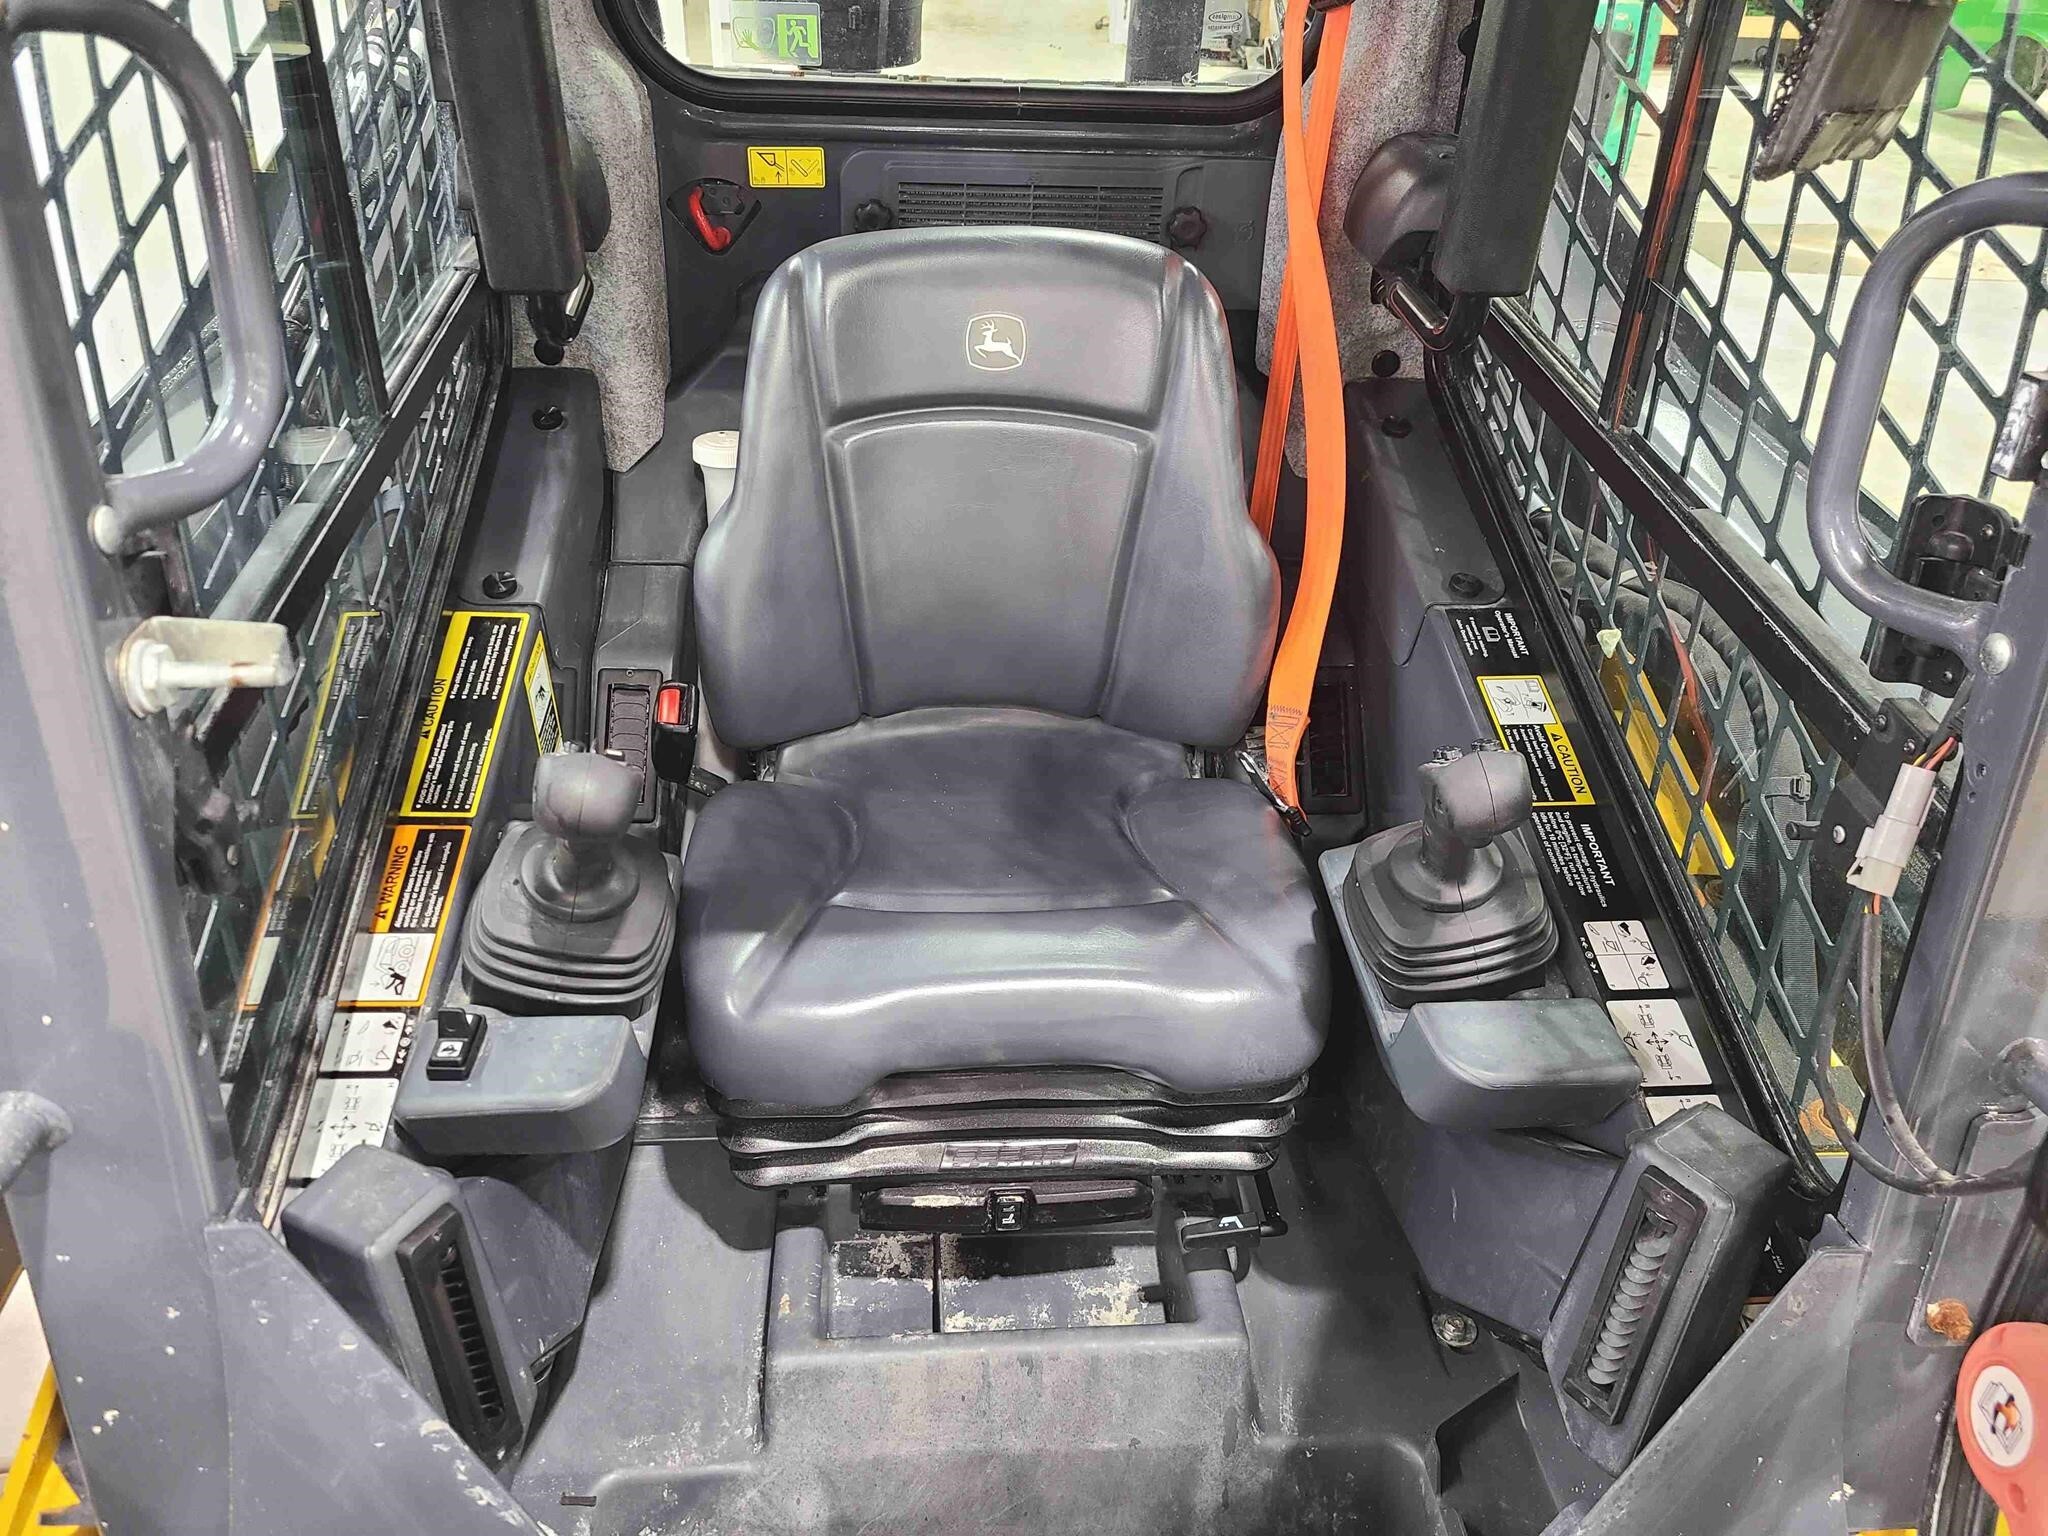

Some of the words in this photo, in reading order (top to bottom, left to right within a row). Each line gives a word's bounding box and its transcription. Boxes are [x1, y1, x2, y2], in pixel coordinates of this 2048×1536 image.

[1466, 625, 1474, 639] contact
[1471, 621, 1480, 635] manual
[1495, 610, 1509, 637] Operator's
[1507, 638, 1519, 658] Manual
[1505, 613, 1528, 654] IMPORTANT
[455, 668, 463, 683] children
[423, 678, 447, 727] CAUTION
[418, 789, 427, 803] AVOID
[423, 771, 432, 788] INJURY
[428, 757, 436, 768] Read
[436, 724, 446, 747] understand
[425, 781, 436, 803] Operator's
[432, 764, 441, 779] Manual
[437, 750, 445, 763] before
[442, 729, 452, 748] operating
[448, 772, 456, 790] location
[455, 745, 464, 762] function
[463, 722, 471, 739] controls.
[1533, 725, 1545, 741] Avoid
[1541, 743, 1556, 769] Overturn
[1557, 745, 1586, 793] CAUTION
[432, 784, 441, 803] machine.
[455, 792, 463, 803] Keep
[459, 778, 467, 791] safety
[463, 761, 472, 777] devices
[468, 742, 478, 760] working.
[1530, 753, 1539, 767] slopes
[1544, 787, 1553, 800] speed
[466, 792, 475, 804] Keep
[1532, 812, 1546, 839] operation
[1546, 848, 1560, 873] controls.
[1547, 812, 1558, 829] below
[1576, 881, 1585, 895] slow
[1552, 842, 1565, 865] minutes
[1562, 867, 1573, 886] before
[1555, 812, 1564, 822] and
[1560, 824, 1572, 845] engine,
[1573, 853, 1592, 893] temperatures
[1565, 820, 1580, 841] prevent
[1576, 843, 1589, 866] damage
[1590, 875, 1607, 907] hydraulics
[1580, 824, 1616, 886] IMPORTANT
[380, 846, 408, 905] WARNING
[394, 909, 405, 927] Always
[400, 892, 410, 908] install
[405, 878, 414, 892] boom
[413, 850, 422, 866] before
[403, 907, 414, 927] working
[414, 874, 423, 891] around
[422, 844, 432, 863] machine
[432, 872, 443, 889] Manual
[412, 902, 422, 917] loader
[417, 887, 427, 901] boom
[421, 917, 429, 927] See
[424, 891, 438, 916] Operator's
